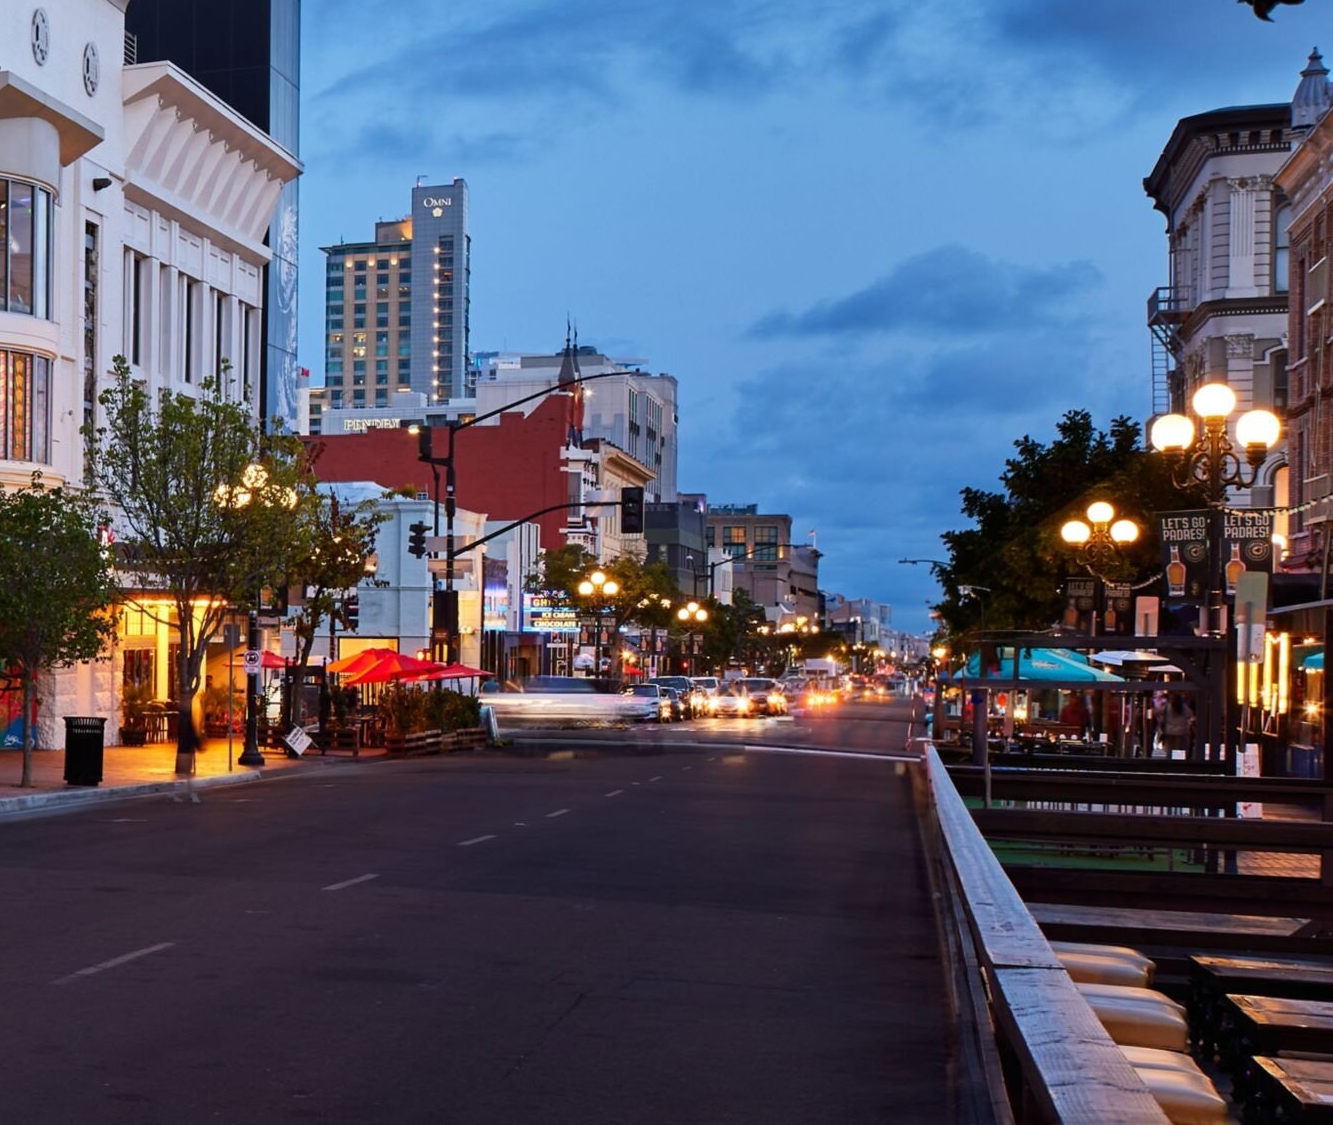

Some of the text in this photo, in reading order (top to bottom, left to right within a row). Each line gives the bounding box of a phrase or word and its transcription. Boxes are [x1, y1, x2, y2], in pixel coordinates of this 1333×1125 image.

[1161, 516, 1206, 529] LET'S GO
[1255, 514, 1270, 526] GO
[1162, 528, 1206, 541] PADRES!
[1224, 526, 1270, 539] PADRES!
